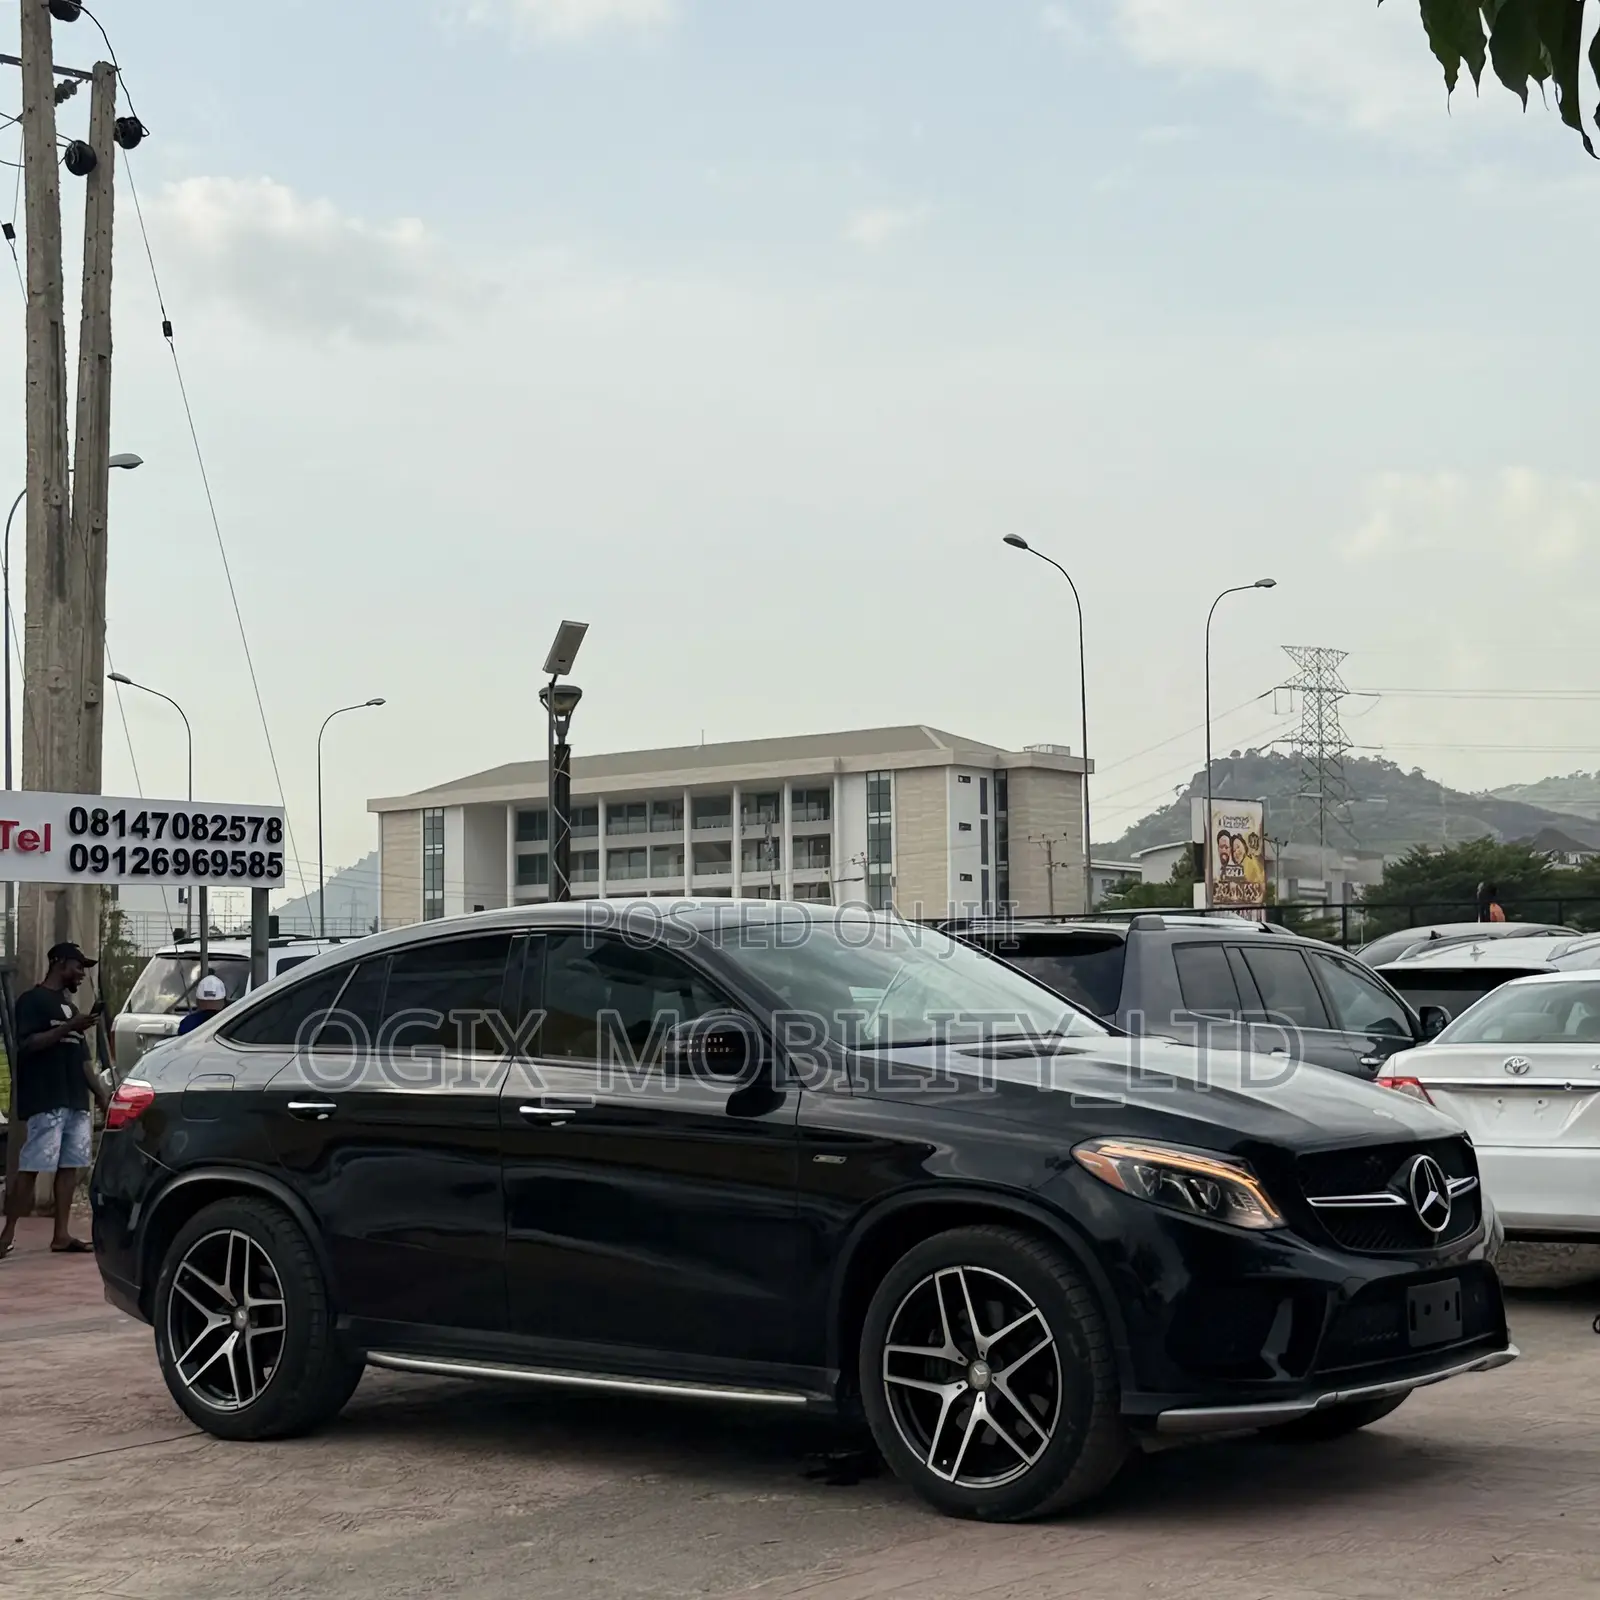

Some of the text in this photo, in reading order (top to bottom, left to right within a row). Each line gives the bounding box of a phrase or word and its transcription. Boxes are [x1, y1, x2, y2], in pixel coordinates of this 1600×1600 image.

[0, 820, 51, 852] Tel
[69, 806, 283, 843] 08147082578
[69, 843, 283, 878] 09126969585
